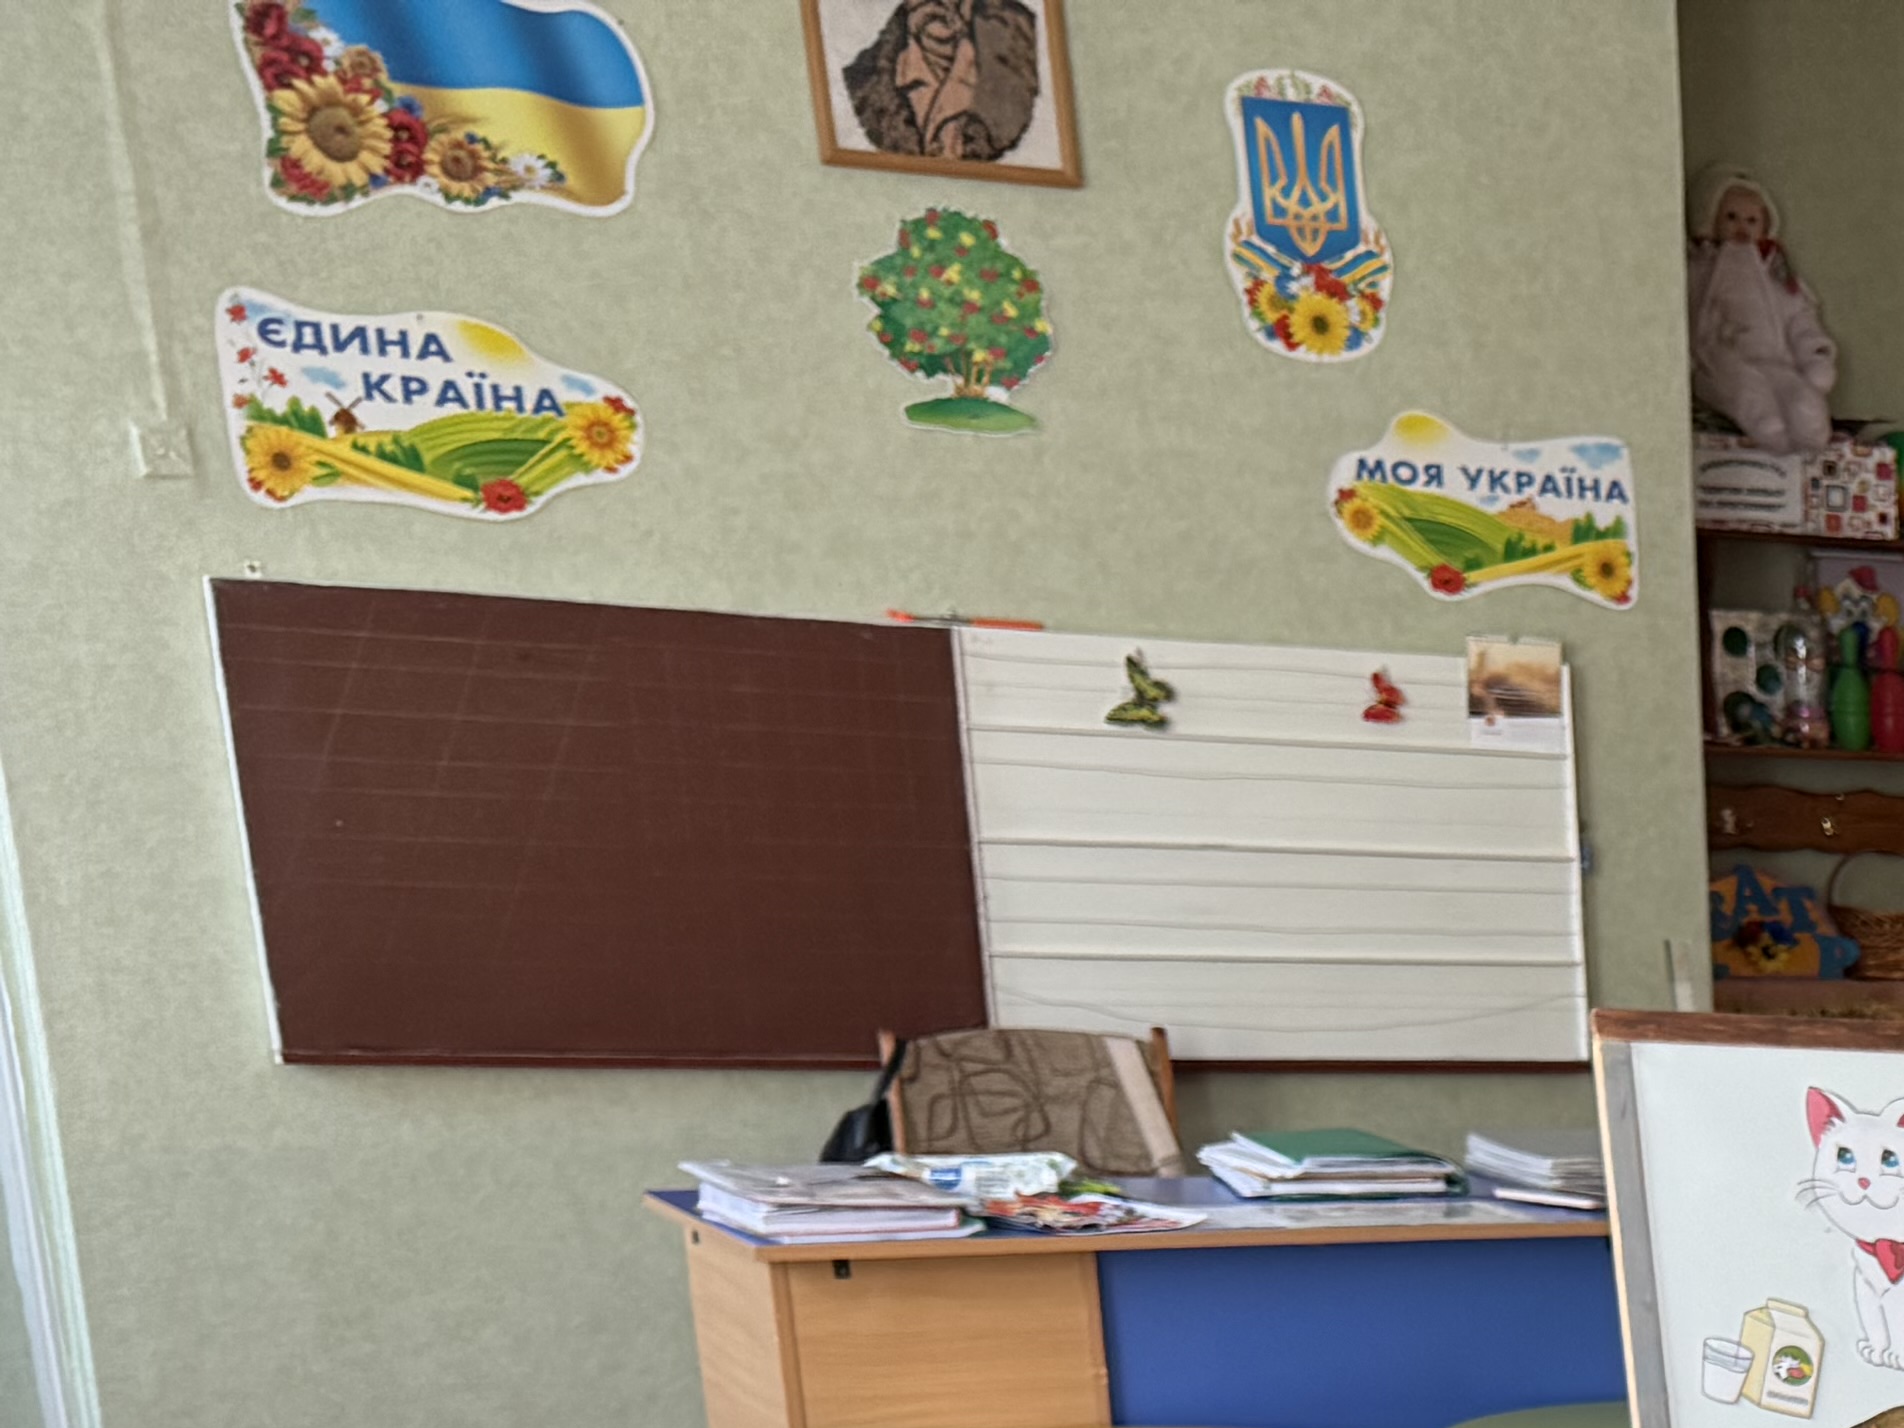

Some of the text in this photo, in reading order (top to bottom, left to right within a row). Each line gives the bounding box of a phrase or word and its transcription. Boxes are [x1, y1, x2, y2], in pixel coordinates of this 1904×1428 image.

[257, 317, 453, 363] ЄДИНА
[361, 370, 566, 417] КРАЇНА
[1355, 457, 1630, 505] МОЯ УКРАЇНА
